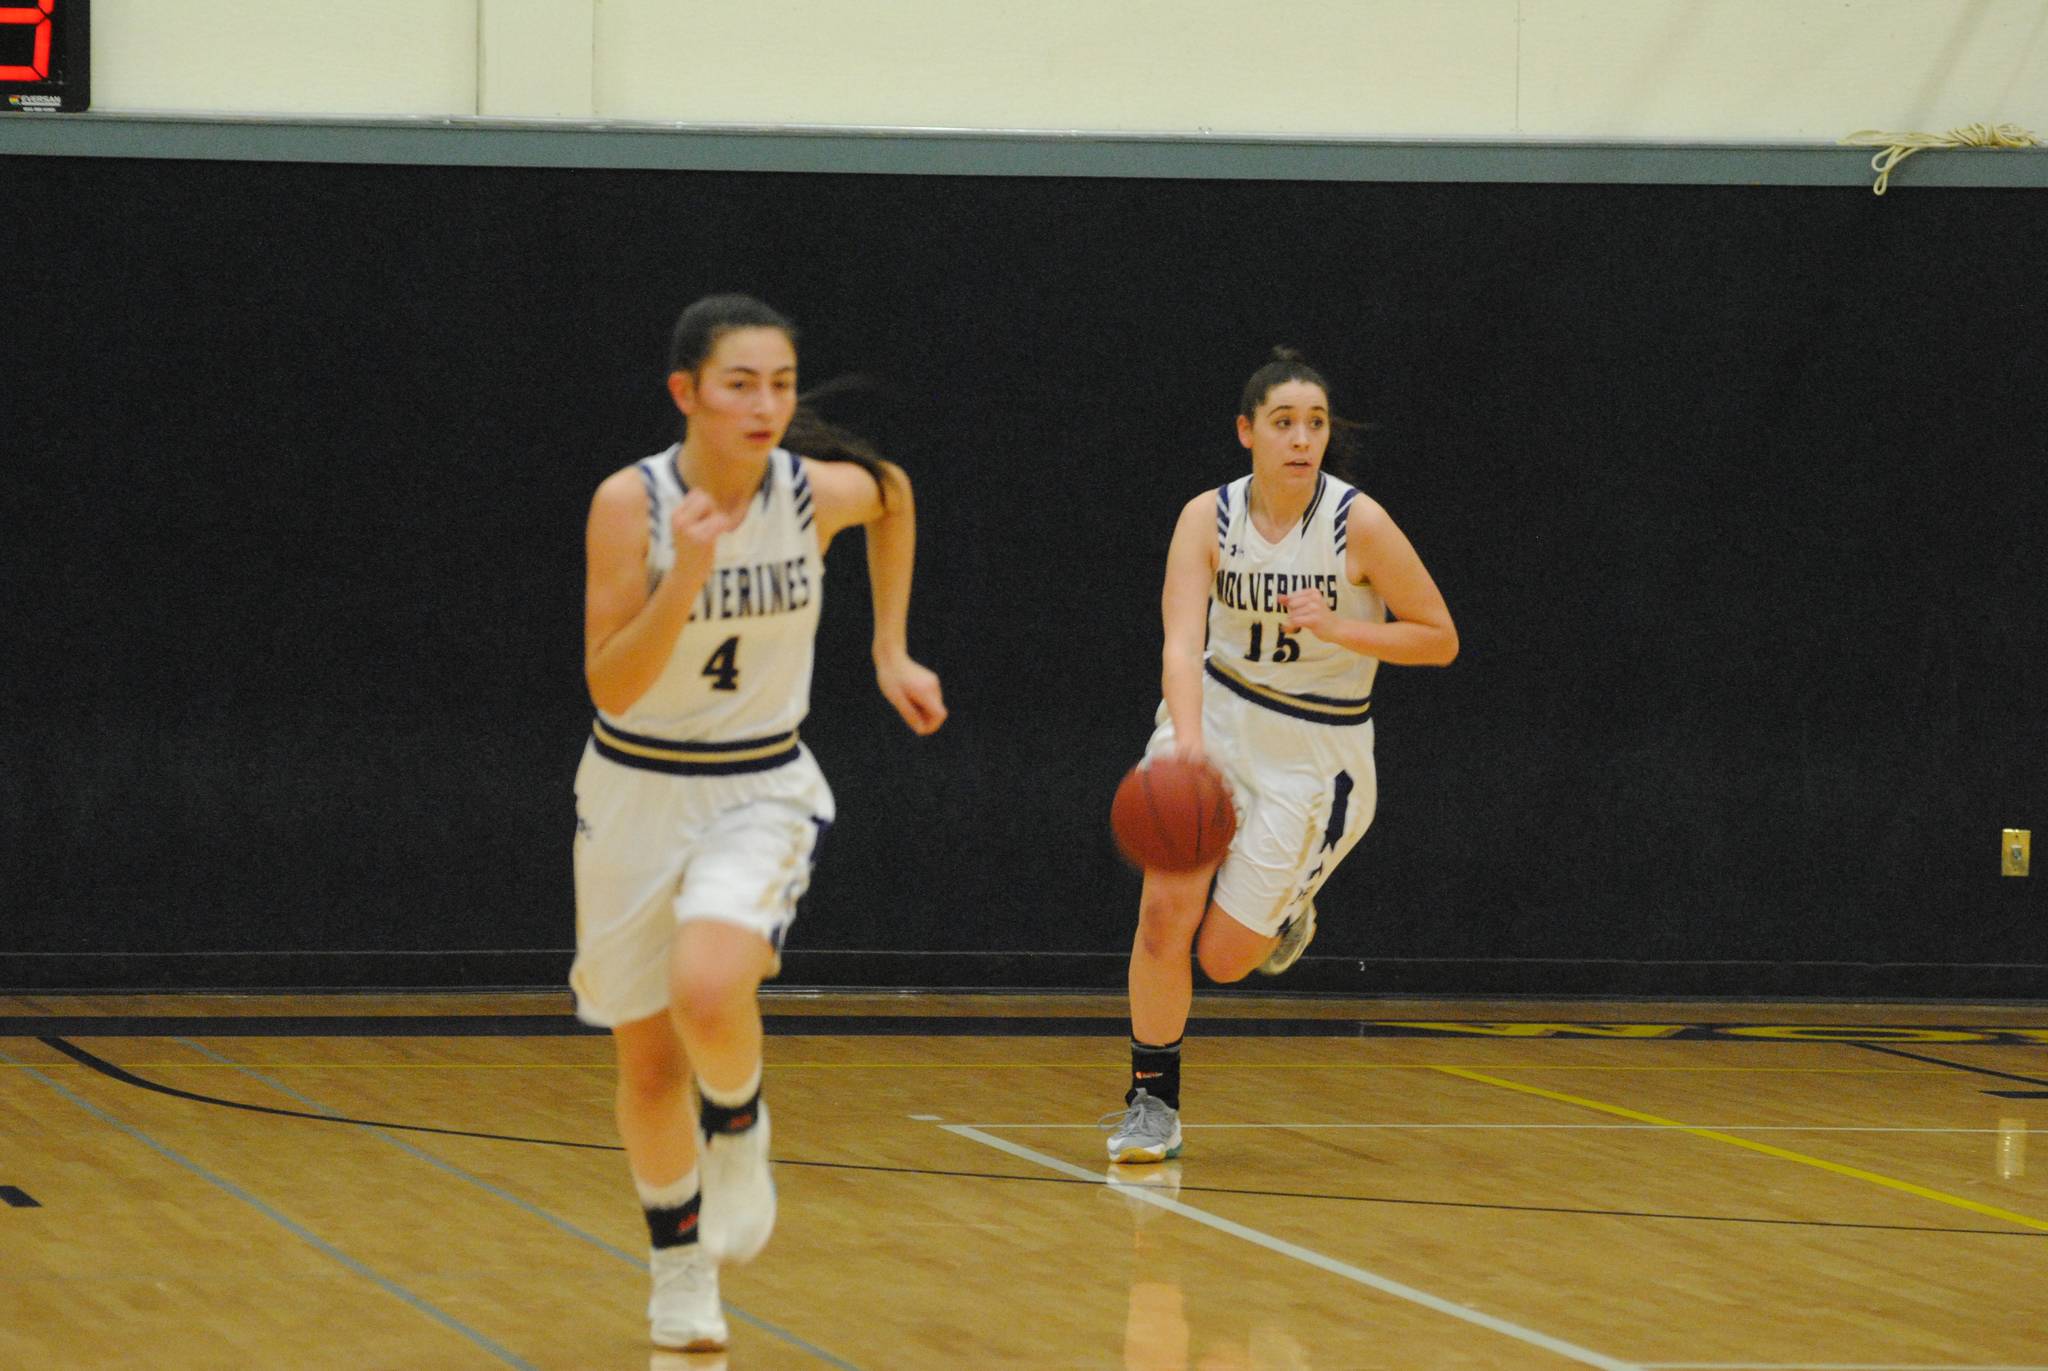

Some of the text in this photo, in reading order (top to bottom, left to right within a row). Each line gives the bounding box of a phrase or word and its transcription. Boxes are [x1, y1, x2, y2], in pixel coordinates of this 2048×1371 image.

[687, 556, 809, 623] VERINES
[701, 634, 740, 692] 4
[1244, 622, 1301, 663] 15
[1375, 1021, 2048, 1044] WO
